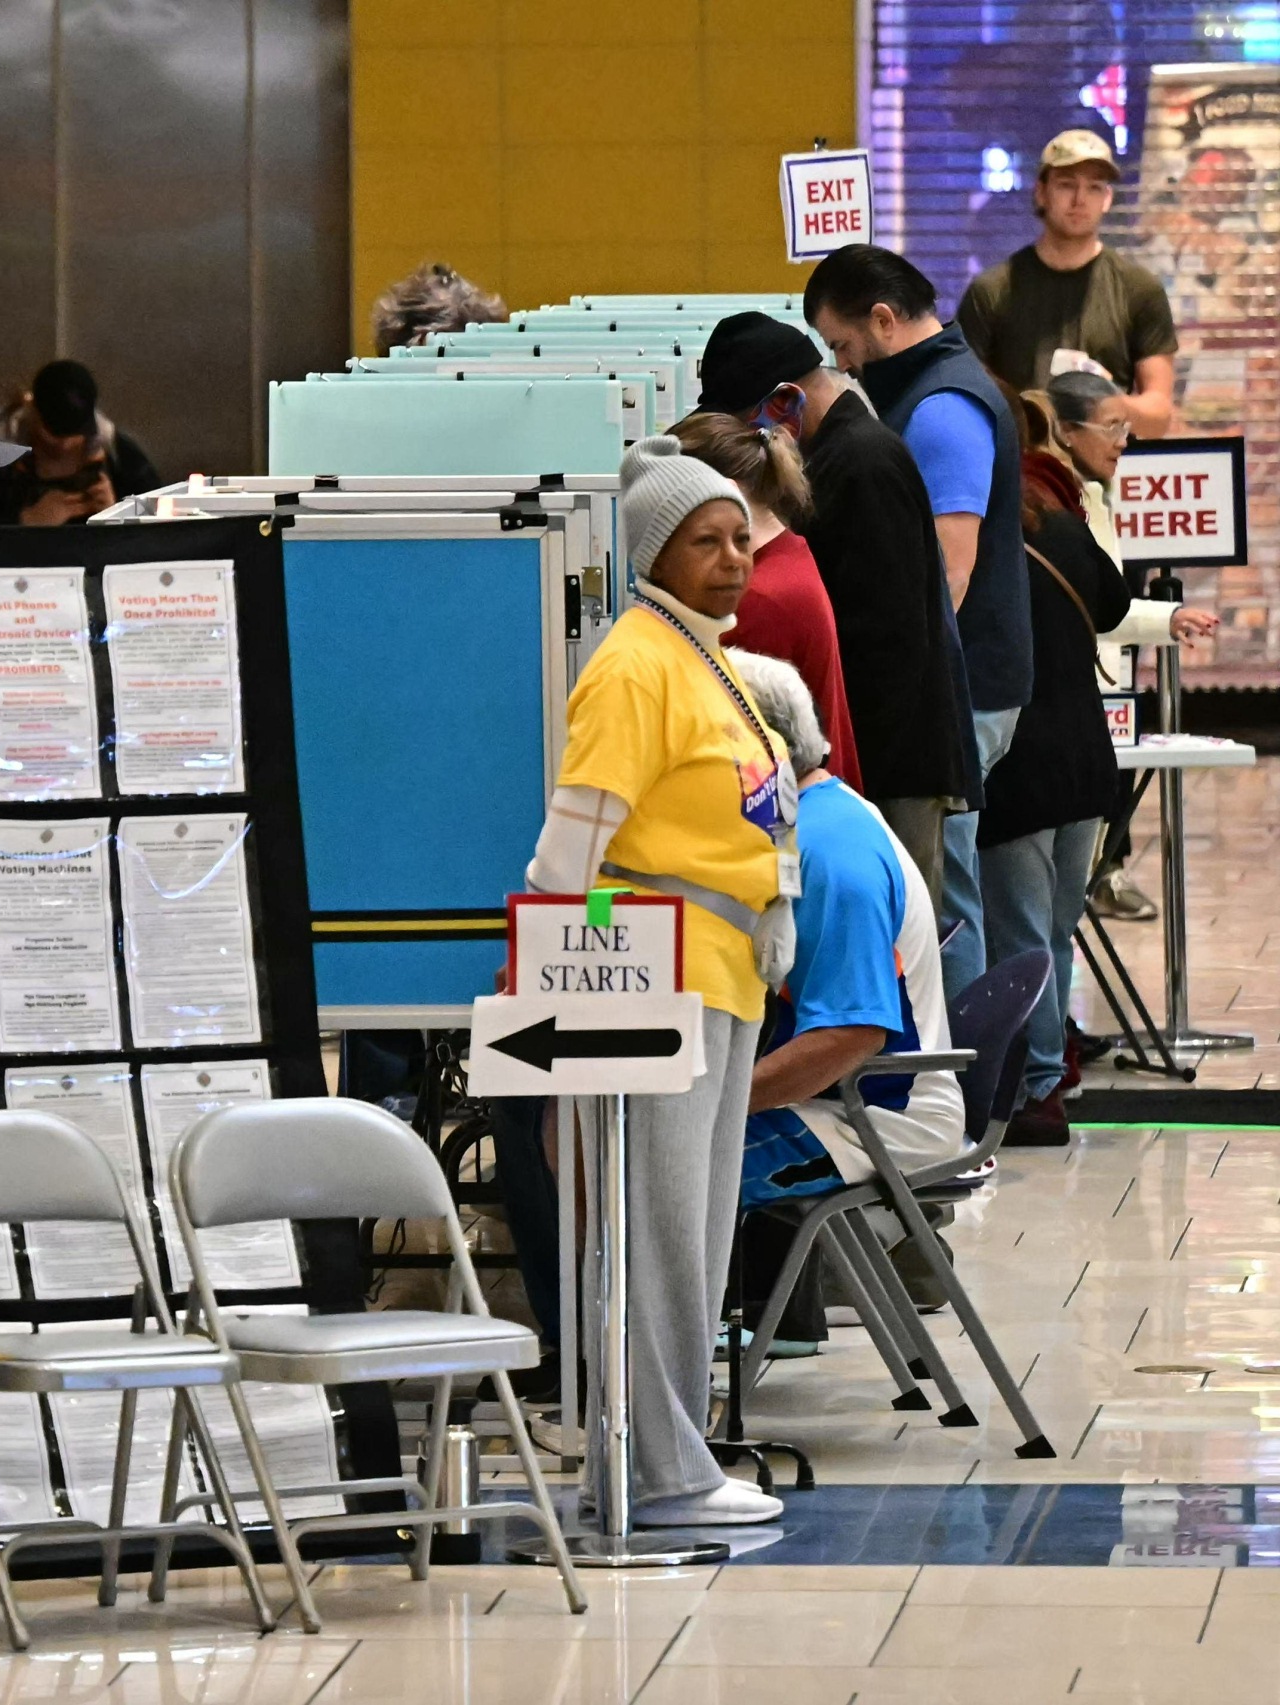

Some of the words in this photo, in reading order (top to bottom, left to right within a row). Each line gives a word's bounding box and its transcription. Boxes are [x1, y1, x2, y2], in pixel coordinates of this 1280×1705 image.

[806, 178, 855, 203] EXIT
[804, 209, 862, 236] HERE
[1120, 473, 1209, 502] EXIT
[1115, 510, 1218, 538] HERE
[14, 600, 57, 610] Phones
[119, 595, 157, 606] Voting
[159, 594, 188, 603] More
[191, 593, 218, 603] Than
[14, 615, 36, 624] and
[123, 609, 152, 619] Once
[155, 608, 216, 618] Prohibited
[1105, 703, 1128, 725] rd
[0, 865, 35, 876] Voting
[38, 864, 92, 874] Machines
[562, 925, 630, 952] LINE
[540, 965, 650, 992] STARTS
